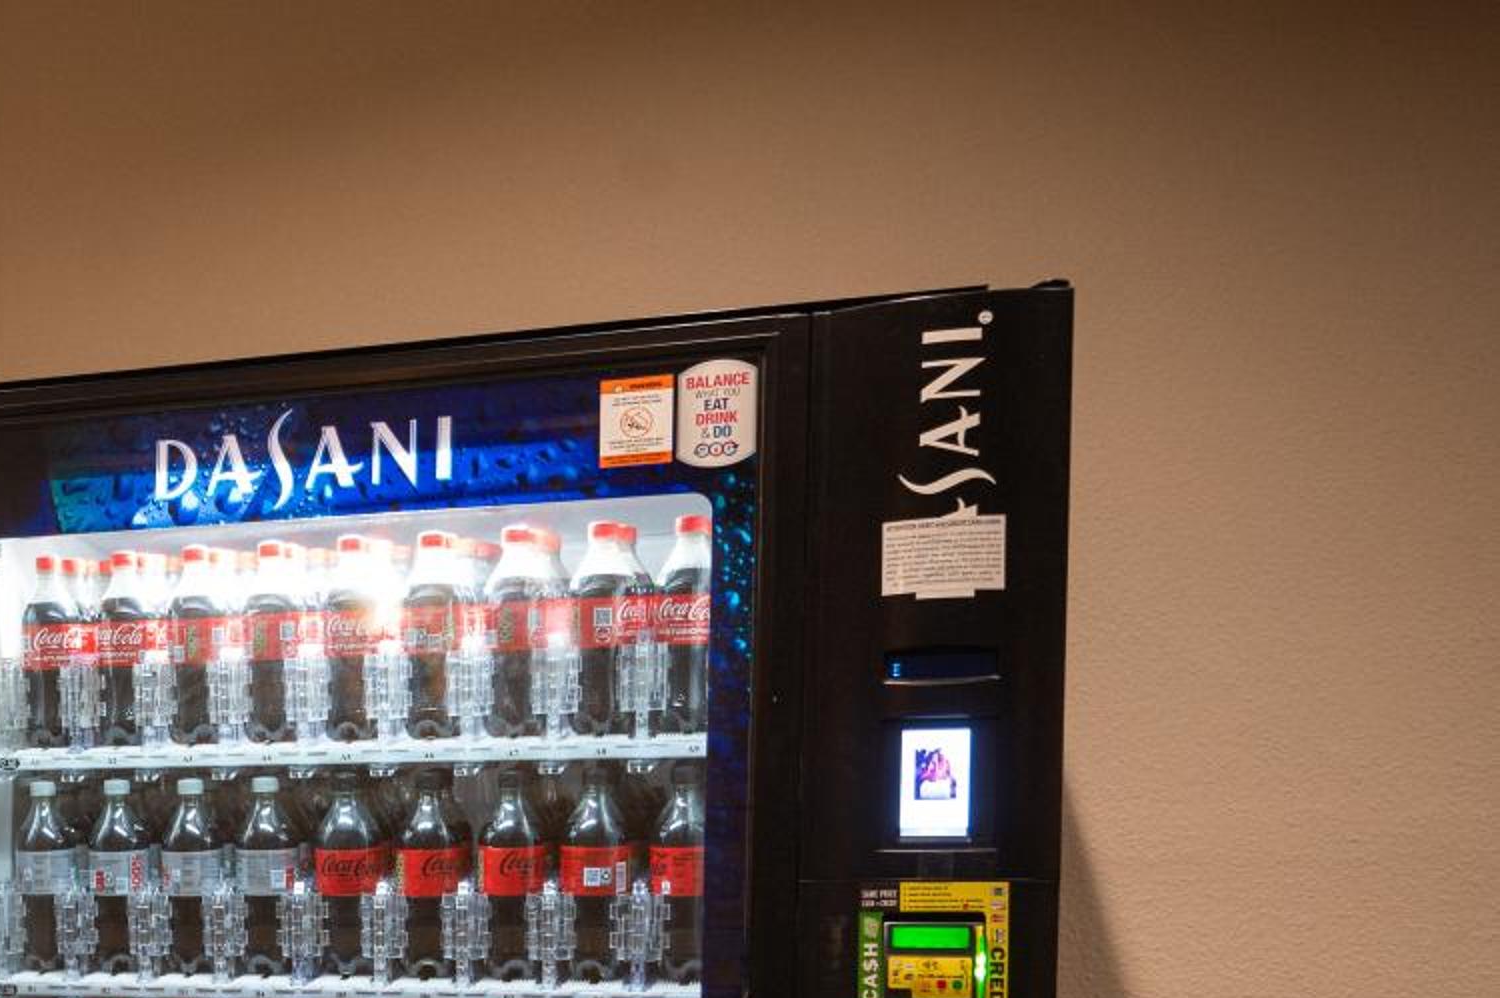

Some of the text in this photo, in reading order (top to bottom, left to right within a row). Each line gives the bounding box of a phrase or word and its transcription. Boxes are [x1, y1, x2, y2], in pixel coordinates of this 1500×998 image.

[685, 372, 751, 390] BALANCE
[723, 388, 741, 397] YOU
[704, 398, 729, 411] EAT
[695, 411, 738, 426] DRINK
[897, 327, 996, 517] SANI
[713, 425, 732, 438] DO
[154, 408, 452, 511] DASANI
